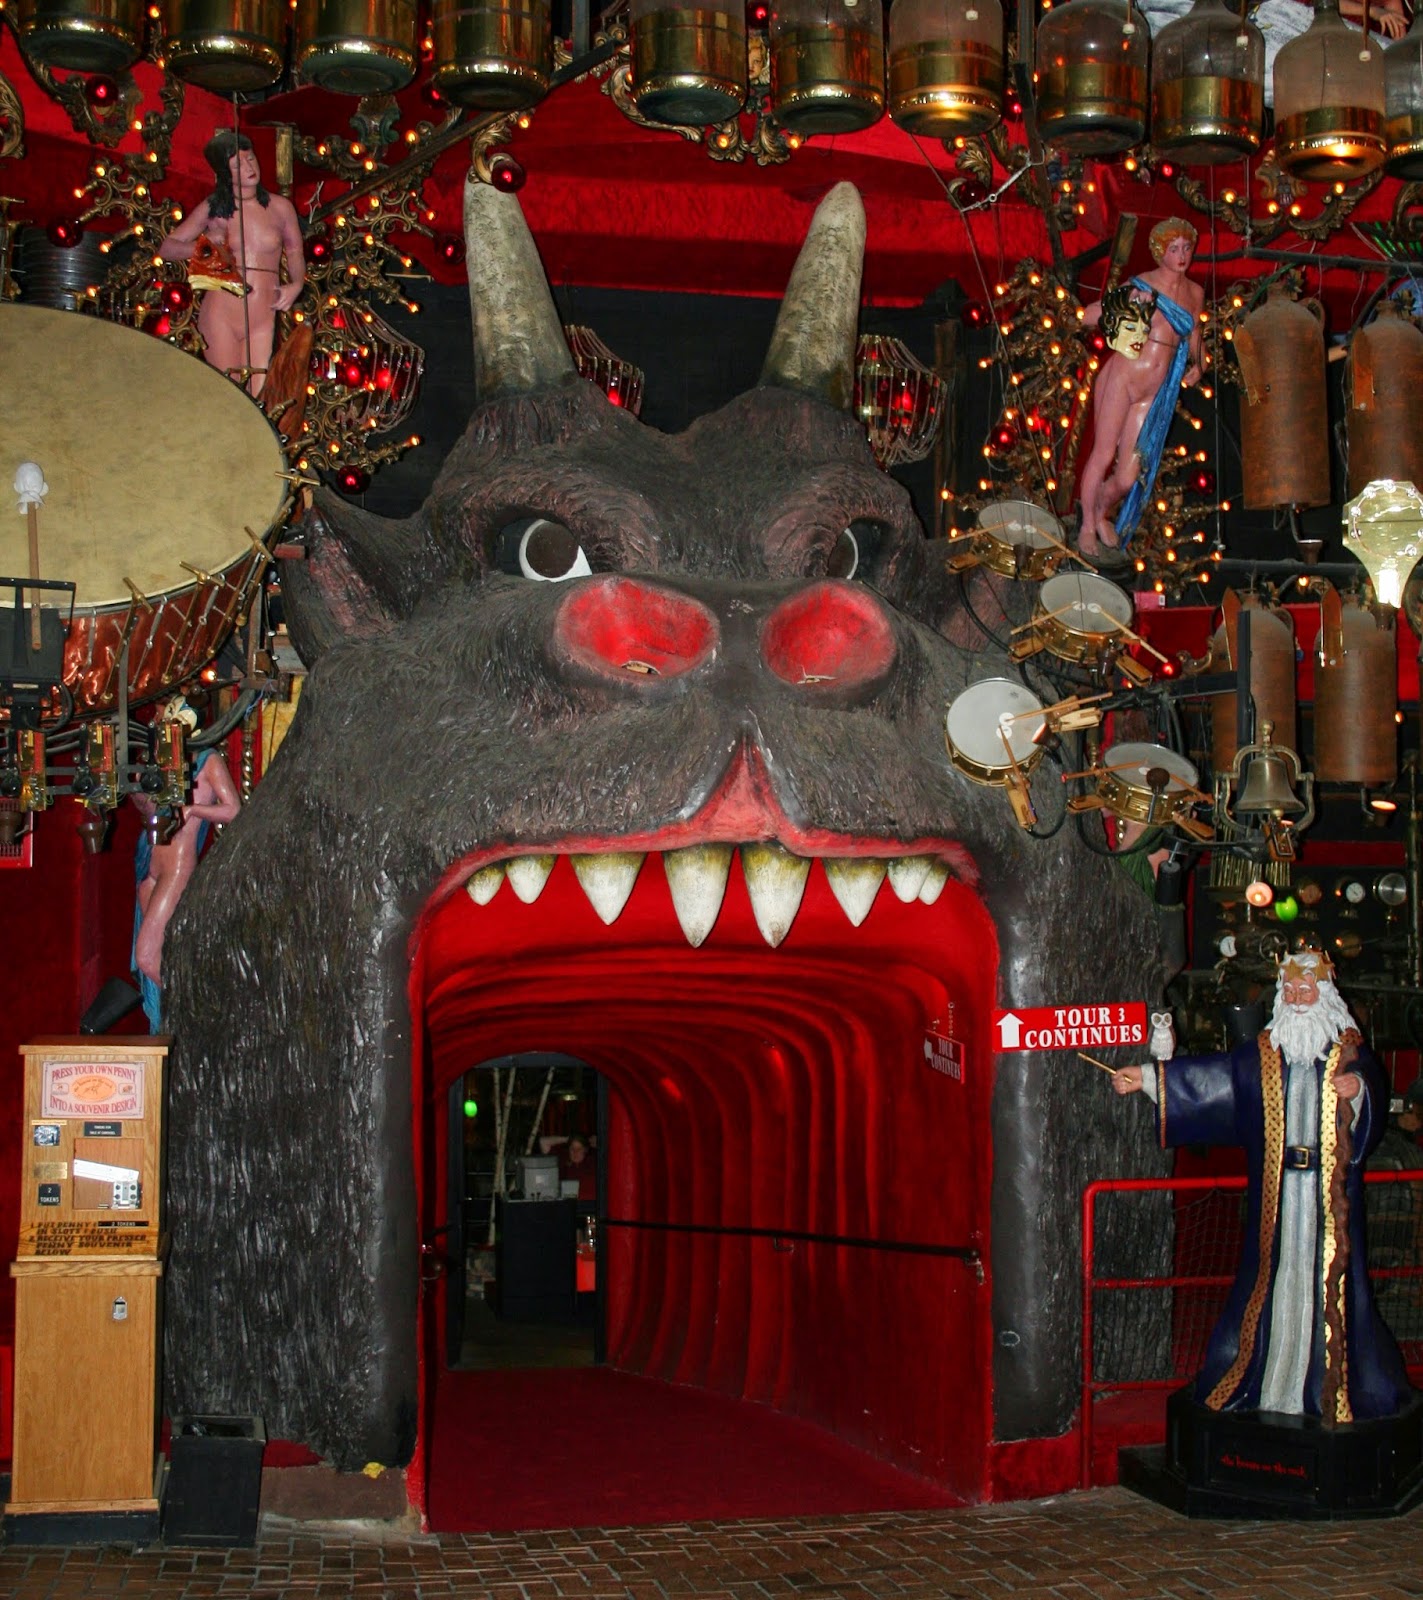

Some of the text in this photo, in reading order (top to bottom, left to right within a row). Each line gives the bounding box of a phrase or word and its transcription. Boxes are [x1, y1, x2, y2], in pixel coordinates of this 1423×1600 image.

[1054, 1006, 1126, 1028] TOUR 3
[1025, 1023, 1142, 1049] CONTINUES
[938, 1037, 953, 1059] TOUR
[52, 1065, 137, 1082] PRESS YOUR OWN PENNY
[50, 1094, 137, 1115] INTO A SOUVENIR DESIGN
[56, 1221, 92, 1229] PENNY
[35, 1241, 133, 1249] PENNY SOUVENIR
